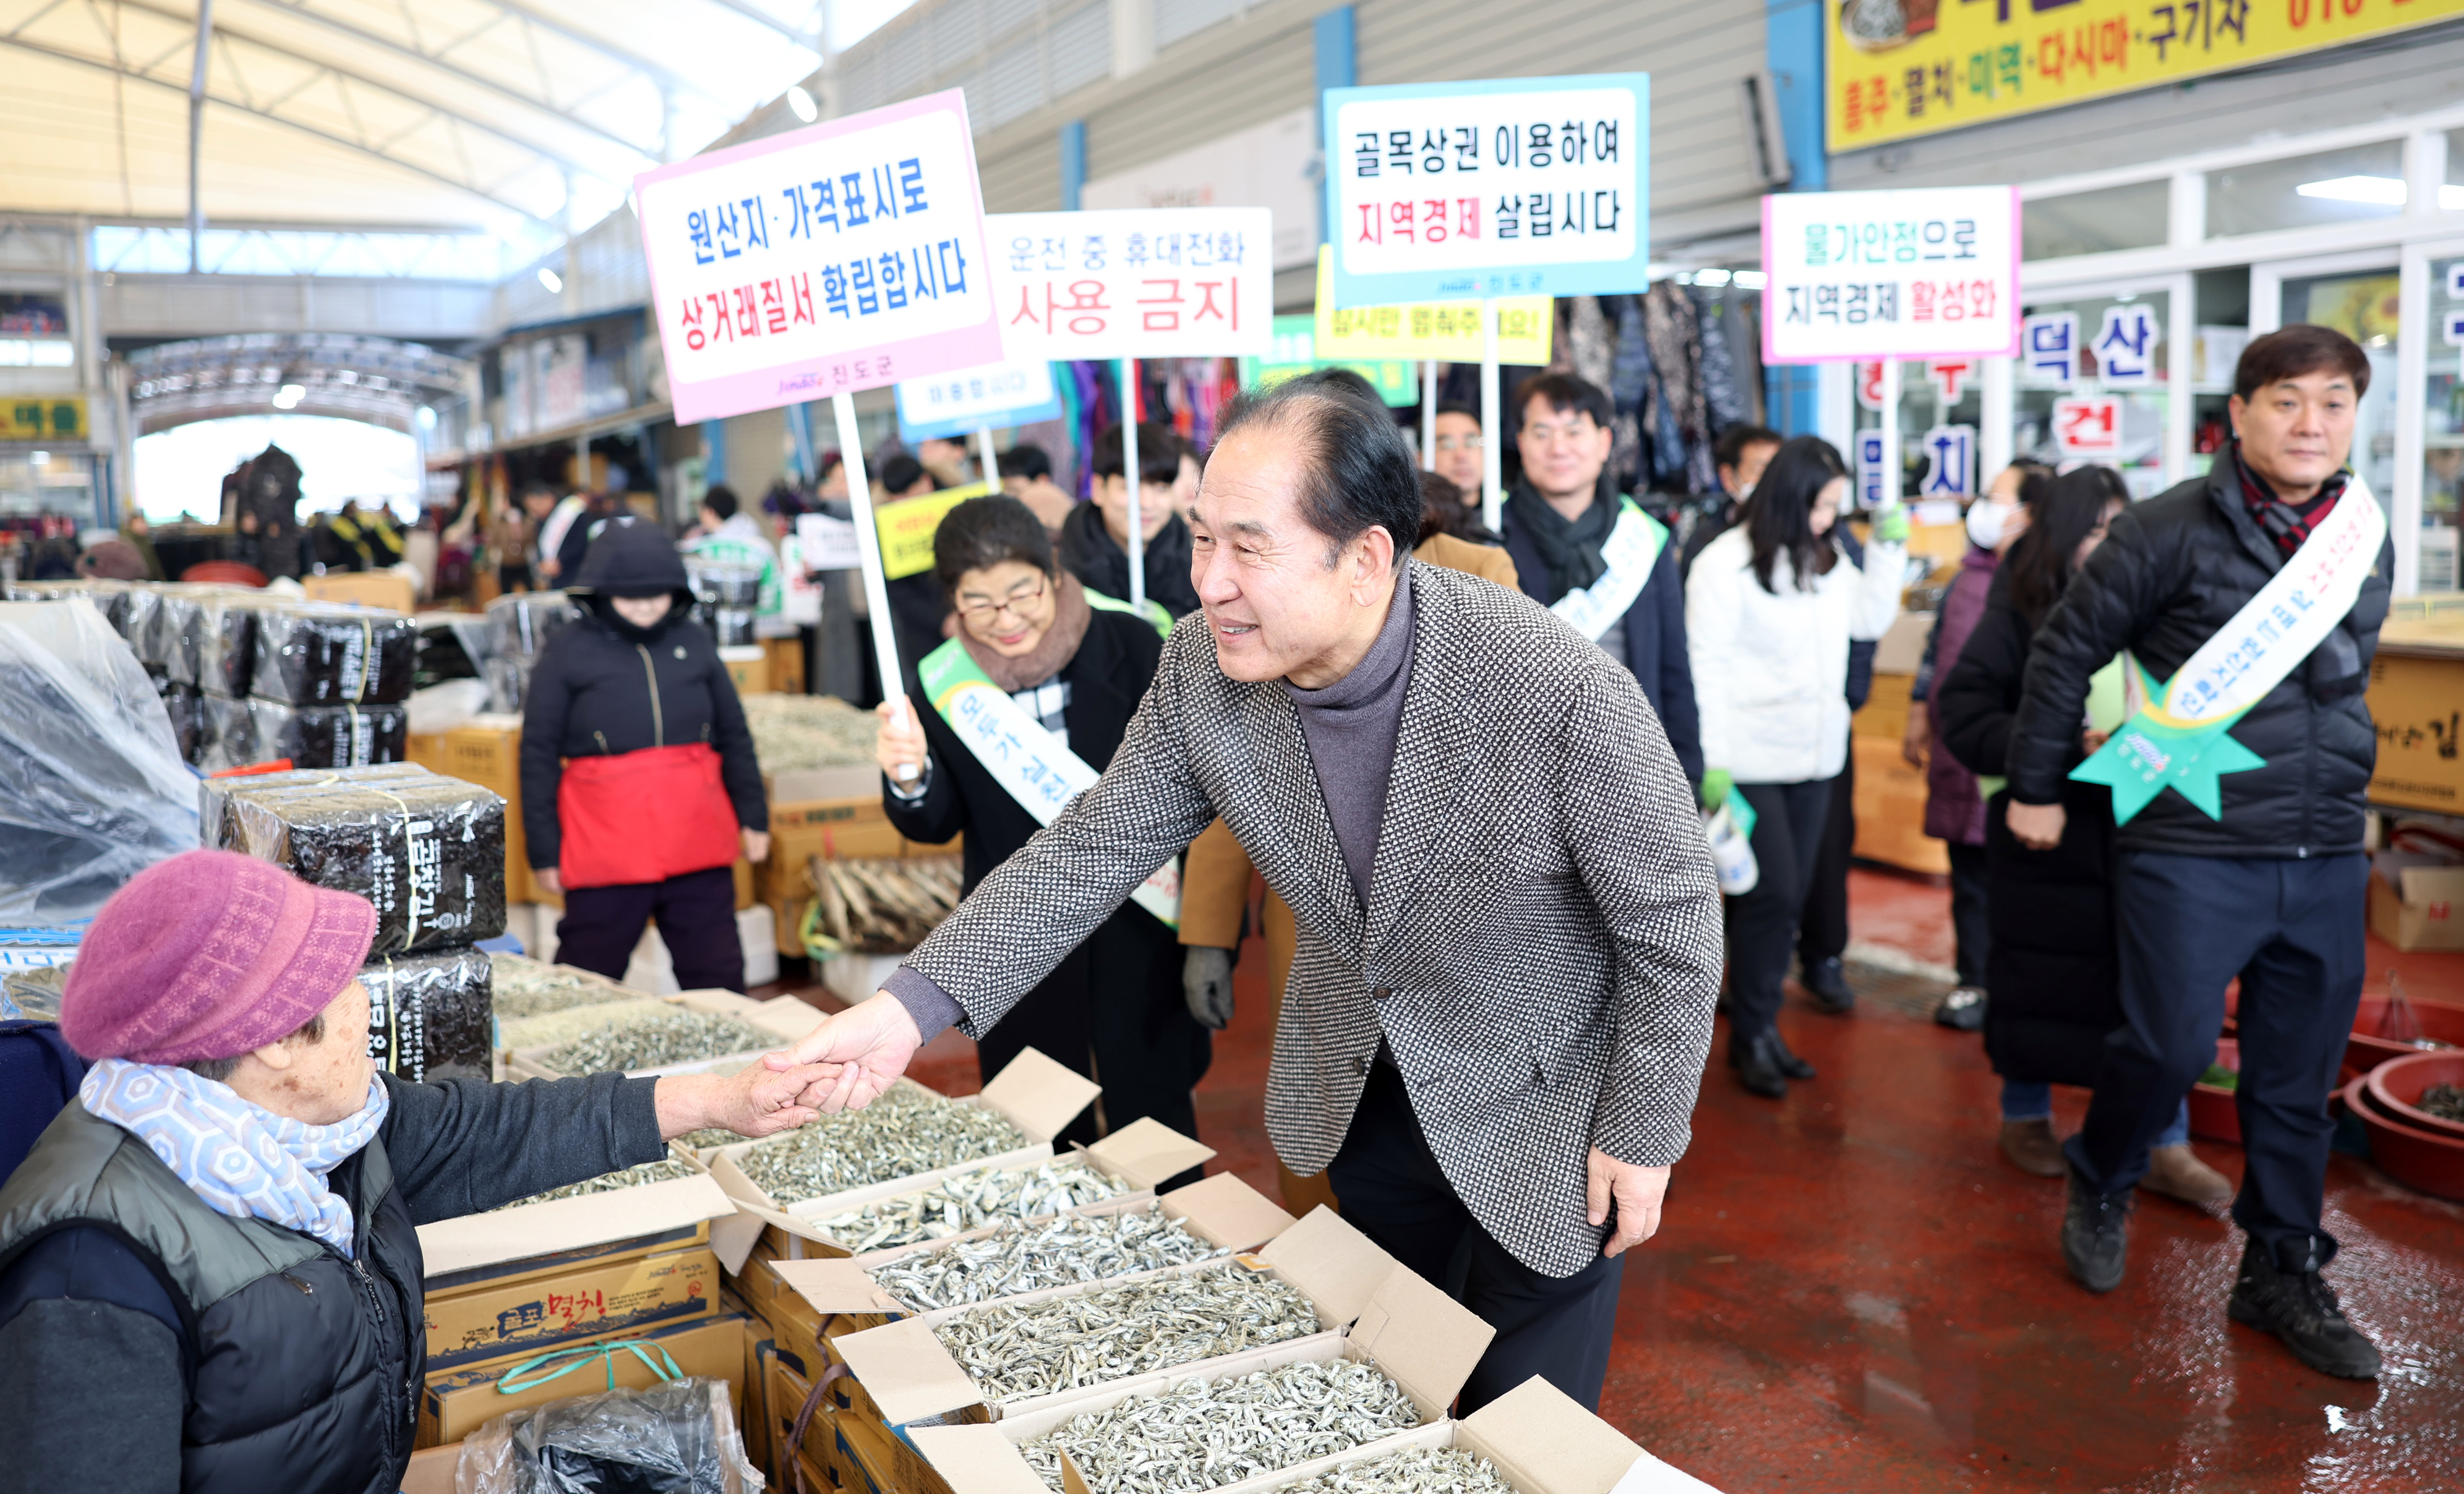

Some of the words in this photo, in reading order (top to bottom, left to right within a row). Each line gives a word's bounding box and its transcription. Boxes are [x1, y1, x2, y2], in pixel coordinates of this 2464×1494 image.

[2039, 12, 2128, 84] 다시마
[2150, 0, 2249, 62] 구기자
[1355, 126, 1479, 177] 골목상권
[1495, 119, 1619, 168] 이용하여
[1358, 197, 1481, 245] 지역경제
[1495, 189, 1621, 239] 살립시다
[1805, 220, 1977, 266] 물가안정으로
[1009, 236, 1066, 271] 운전
[1081, 234, 1108, 271] 중
[1124, 231, 1246, 268] 휴대전화
[682, 271, 816, 351] 상거래질서
[821, 237, 967, 319] 확립합시다
[1010, 279, 1111, 335] 사용
[1136, 276, 1239, 331] 금지
[1786, 281, 1897, 325] 지역경제
[1910, 279, 1996, 322] 활성화
[832, 354, 893, 385] 진도군
[2032, 314, 2150, 382] 덕산
[2211, 636, 2267, 688] 원산지
[2180, 679, 2220, 719] 확인
[959, 693, 1022, 761] 모두가
[1021, 754, 1087, 809] 실천
[408, 839, 435, 916] 곱창김
[504, 1308, 542, 1331] 굴포
